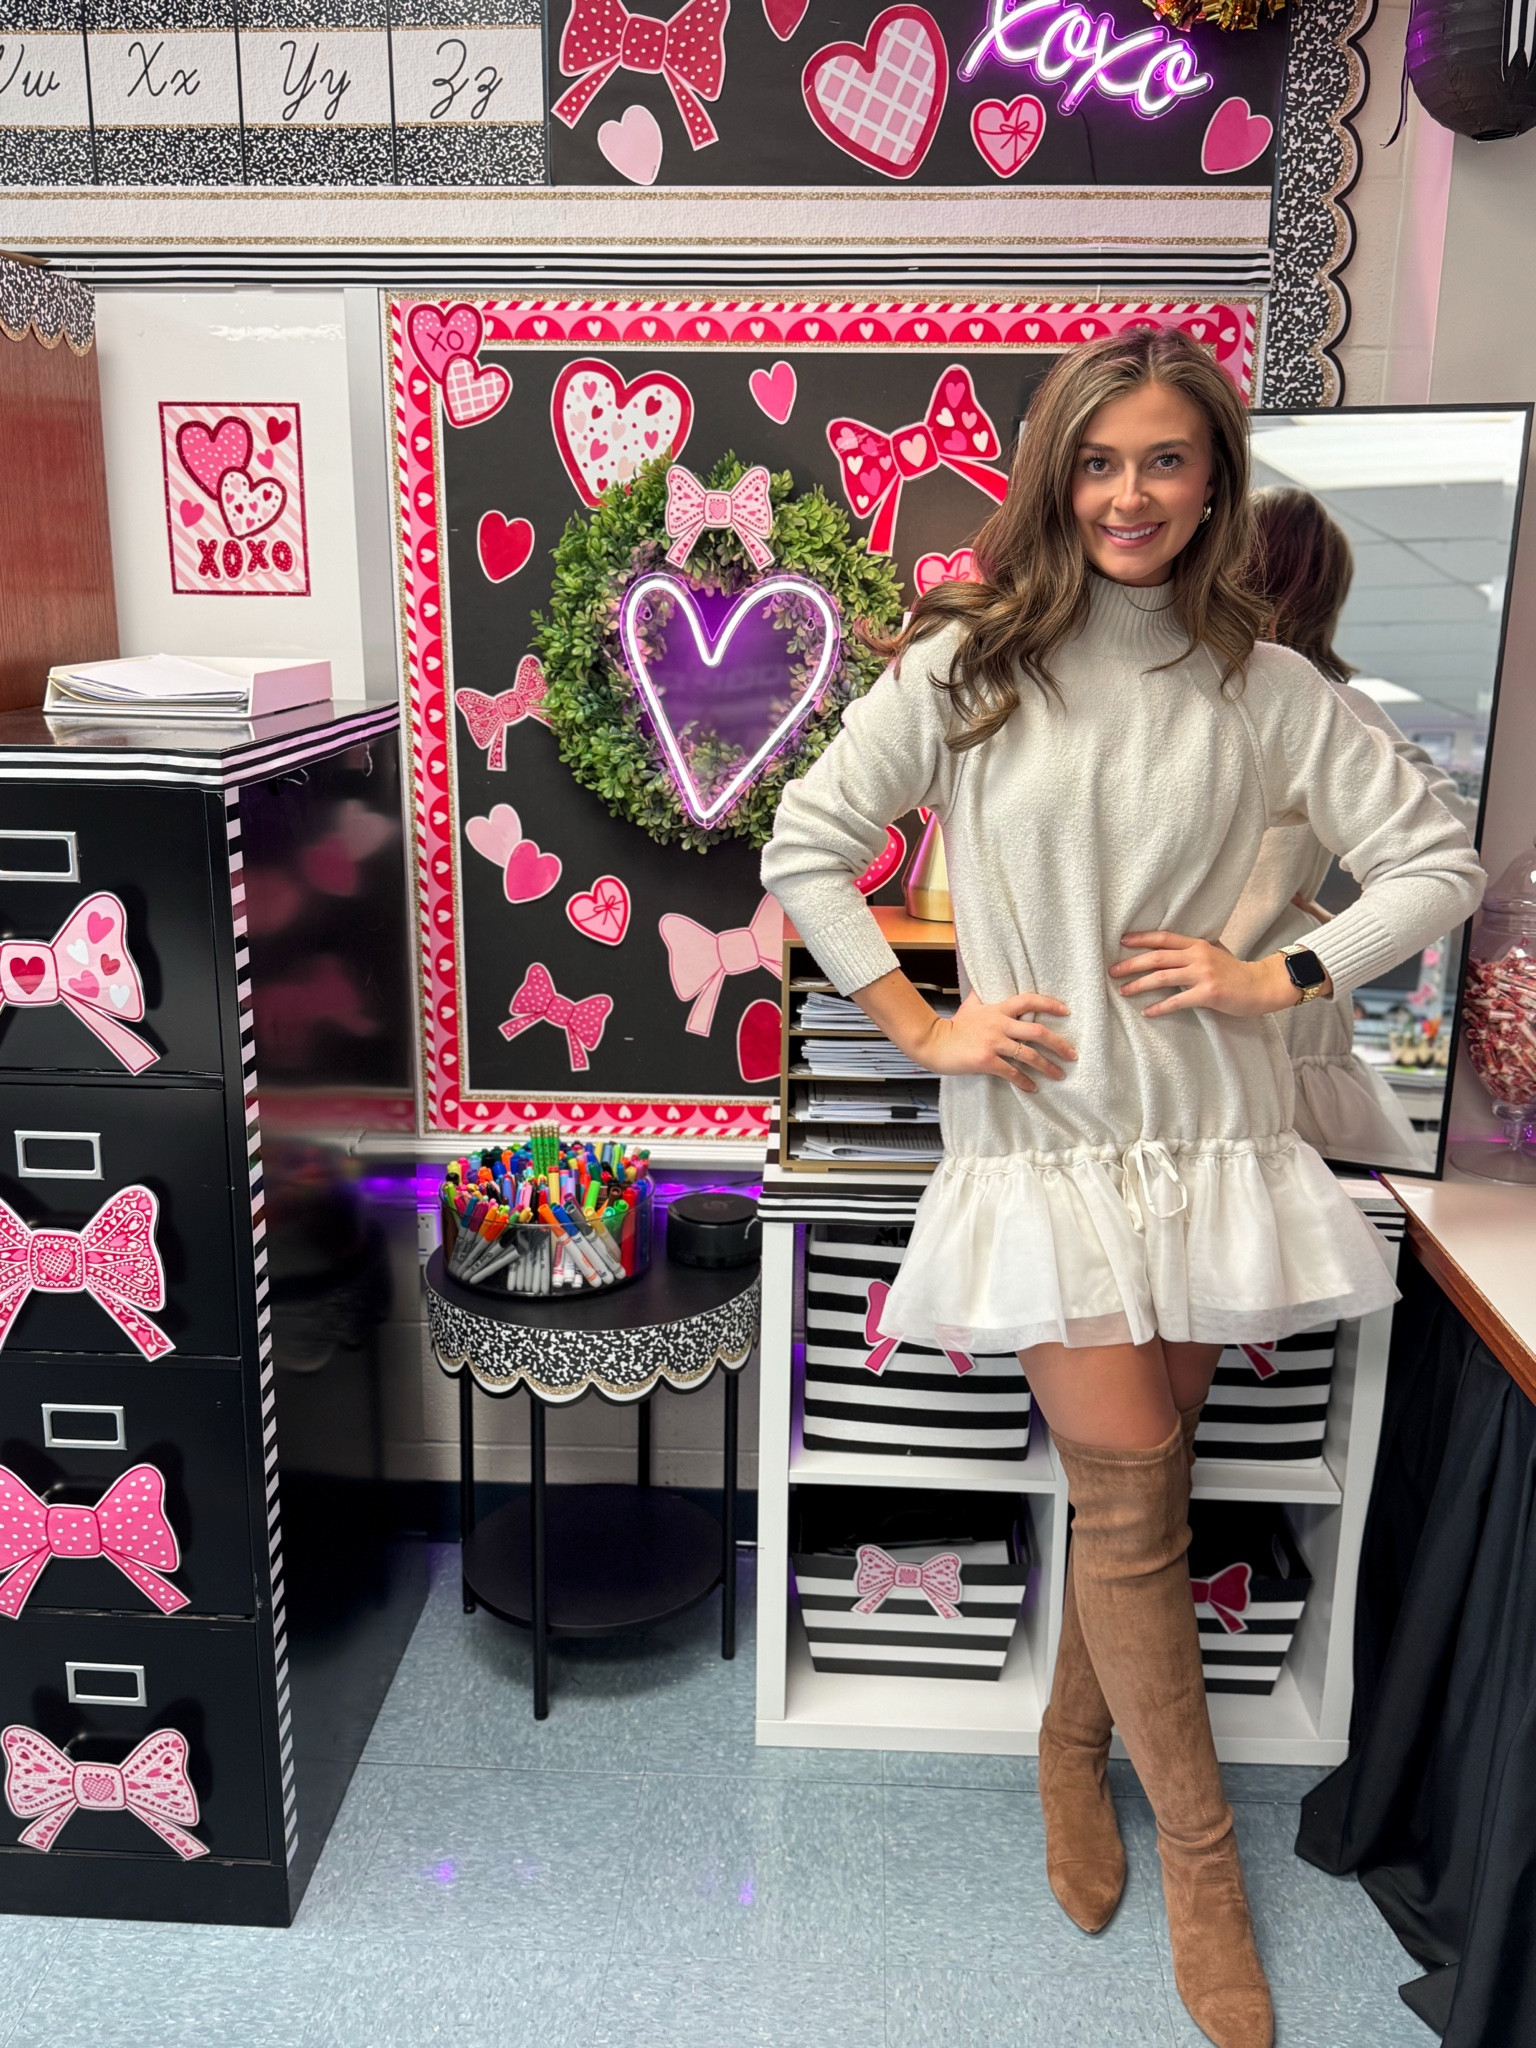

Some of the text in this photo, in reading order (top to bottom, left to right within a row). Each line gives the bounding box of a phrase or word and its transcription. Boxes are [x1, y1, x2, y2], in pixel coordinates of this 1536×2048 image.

[127, 41, 201, 97] Xx
[279, 40, 352, 121] Yy
[429, 38, 504, 120] Zz
[426, 330, 464, 352] XO
[196, 539, 293, 579] XOXO
